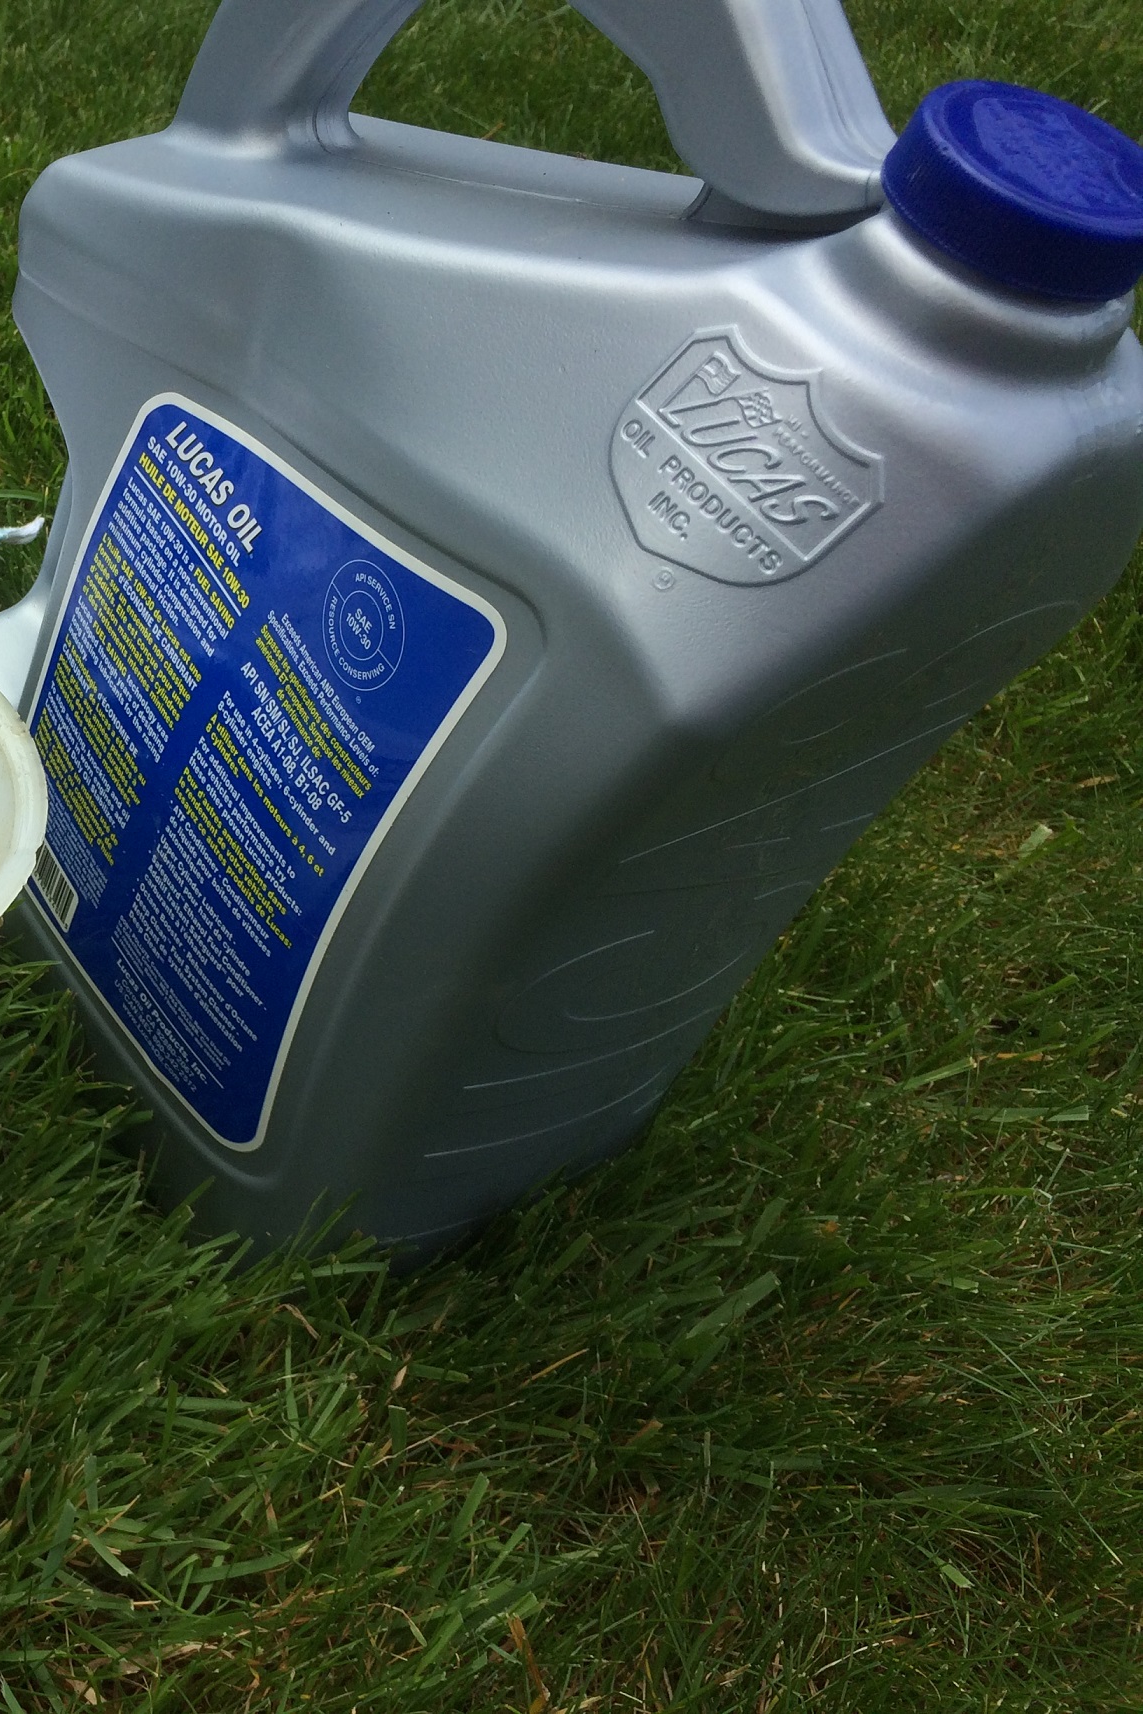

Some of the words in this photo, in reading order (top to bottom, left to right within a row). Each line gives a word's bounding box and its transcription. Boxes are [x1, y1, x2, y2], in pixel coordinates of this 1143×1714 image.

[147, 436, 168, 465] SAE
[166, 460, 198, 503] 10W-30
[194, 497, 228, 546] MOTOR
[225, 541, 241, 568] OIL
[164, 421, 235, 505] LUCAS
[226, 503, 263, 553] OIL
[620, 418, 656, 460] OIL
[657, 454, 784, 575] PRODUCTS
[647, 490, 689, 542] INC.
[657, 396, 840, 526] LUCAS
[107, 521, 135, 562] minimum
[133, 556, 159, 594] internal
[156, 589, 179, 627] friction.
[112, 510, 142, 553] maximum
[140, 550, 166, 585] cylinder
[163, 583, 202, 640] compression
[200, 637, 215, 658] and
[117, 500, 142, 535] additive
[139, 532, 168, 573] package.
[167, 568, 176, 582] It
[173, 576, 181, 590] is
[179, 587, 209, 630] designed
[206, 625, 218, 642] for
[122, 487, 147, 524] formula
[145, 518, 167, 549] based
[163, 546, 174, 561] on
[177, 565, 230, 640] non-conventional
[127, 476, 148, 507] Lucas
[146, 502, 162, 525] SAE
[160, 521, 184, 555] 10W-30
[181, 550, 190, 565] is
[193, 567, 211, 596] FUEL
[209, 591, 235, 630] SAVING
[138, 452, 166, 489] HUILE
[162, 482, 178, 505] DE
[173, 498, 209, 549] MOTEUR
[206, 543, 225, 571] SAE
[222, 567, 250, 609] 10W-30
[77, 595, 94, 624] Lucas
[92, 619, 107, 646] FUEL
[105, 642, 128, 678] SAVING
[126, 674, 157, 725] technology
[156, 721, 169, 743] was
[120, 559, 135, 582] SAE
[133, 578, 155, 611] 10W-30
[153, 609, 162, 624] de
[160, 619, 180, 650] Lucas
[178, 647, 191, 666] est
[188, 662, 202, 683] une
[151, 623, 163, 641] DE
[160, 636, 198, 691] CARBURANT
[328, 595, 340, 658] RESOURCE
[338, 656, 385, 681] CONSERVING
[346, 612, 372, 650] 10W-30
[355, 573, 367, 583] API
[367, 575, 393, 613] SERVICE
[388, 614, 396, 630] SN
[355, 608, 373, 634] SAE
[205, 722, 213, 733] 8
[210, 731, 239, 778] cylindres.
[217, 700, 248, 748] 8-cylinder
[246, 747, 272, 790] engines.
[240, 661, 260, 686] API
[299, 755, 330, 795] ILSAC
[326, 792, 353, 824] GF-5
[260, 624, 284, 661] Surpasse
[280, 657, 291, 674] les
[319, 722, 332, 739] des
[330, 737, 372, 791] constructeurs
[267, 609, 299, 665] Specifications.
[297, 660, 319, 695] Exceeds
[316, 690, 351, 742] Performance
[348, 737, 370, 767] Levels
[368, 764, 380, 778] of:
[276, 688, 285, 701] de
[281, 699, 314, 747] performance
[311, 745, 323, 761] de:
[278, 671, 289, 685] ET
[308, 721, 334, 759] Surpasse
[331, 755, 343, 771] les
[339, 768, 365, 799] niveaux
[281, 612, 302, 648] Exceeds
[298, 644, 323, 682] American
[319, 678, 335, 698] AND
[331, 694, 359, 735] European
[357, 731, 376, 753] OEM
[178, 776, 186, 789] le
[185, 787, 218, 838] rendement
[217, 836, 226, 851] de
[226, 849, 244, 875] votre
[192, 747, 209, 769] your
[207, 767, 233, 809] vehicles
[230, 807, 275, 868] performance
[274, 865, 287, 883] try
[198, 735, 210, 754] For
[208, 754, 241, 802] additional
[238, 798, 287, 868] improvements
[286, 865, 296, 879] to
[216, 722, 239, 757] utiliser
[237, 756, 254, 782] dans
[252, 778, 264, 798] les
[262, 796, 292, 838] moteurs
[307, 854, 315, 865] 6
[313, 864, 324, 877] et
[222, 690, 235, 710] For
[233, 708, 246, 728] use
[244, 724, 253, 739] in
[251, 737, 283, 790] 4-cylinder,
[283, 785, 319, 835] 6-cylinder
[318, 834, 336, 856] and
[250, 706, 276, 743] ACEA
[270, 738, 297, 779] A1-08,
[294, 772, 323, 811] B1-08
[174, 787, 199, 824] essayez
[197, 822, 207, 837] ce
[206, 835, 227, 867] autres
[225, 865, 256, 905] produits
[255, 904, 266, 918] de
[265, 915, 292, 949] Lucas:
[183, 766, 199, 791] Pour
[267, 890, 287, 915] dans
[188, 755, 207, 785] these
[205, 783, 224, 809] other
[220, 808, 245, 843] proven
[244, 839, 266, 872] Lucas
[264, 870, 303, 916] products:
